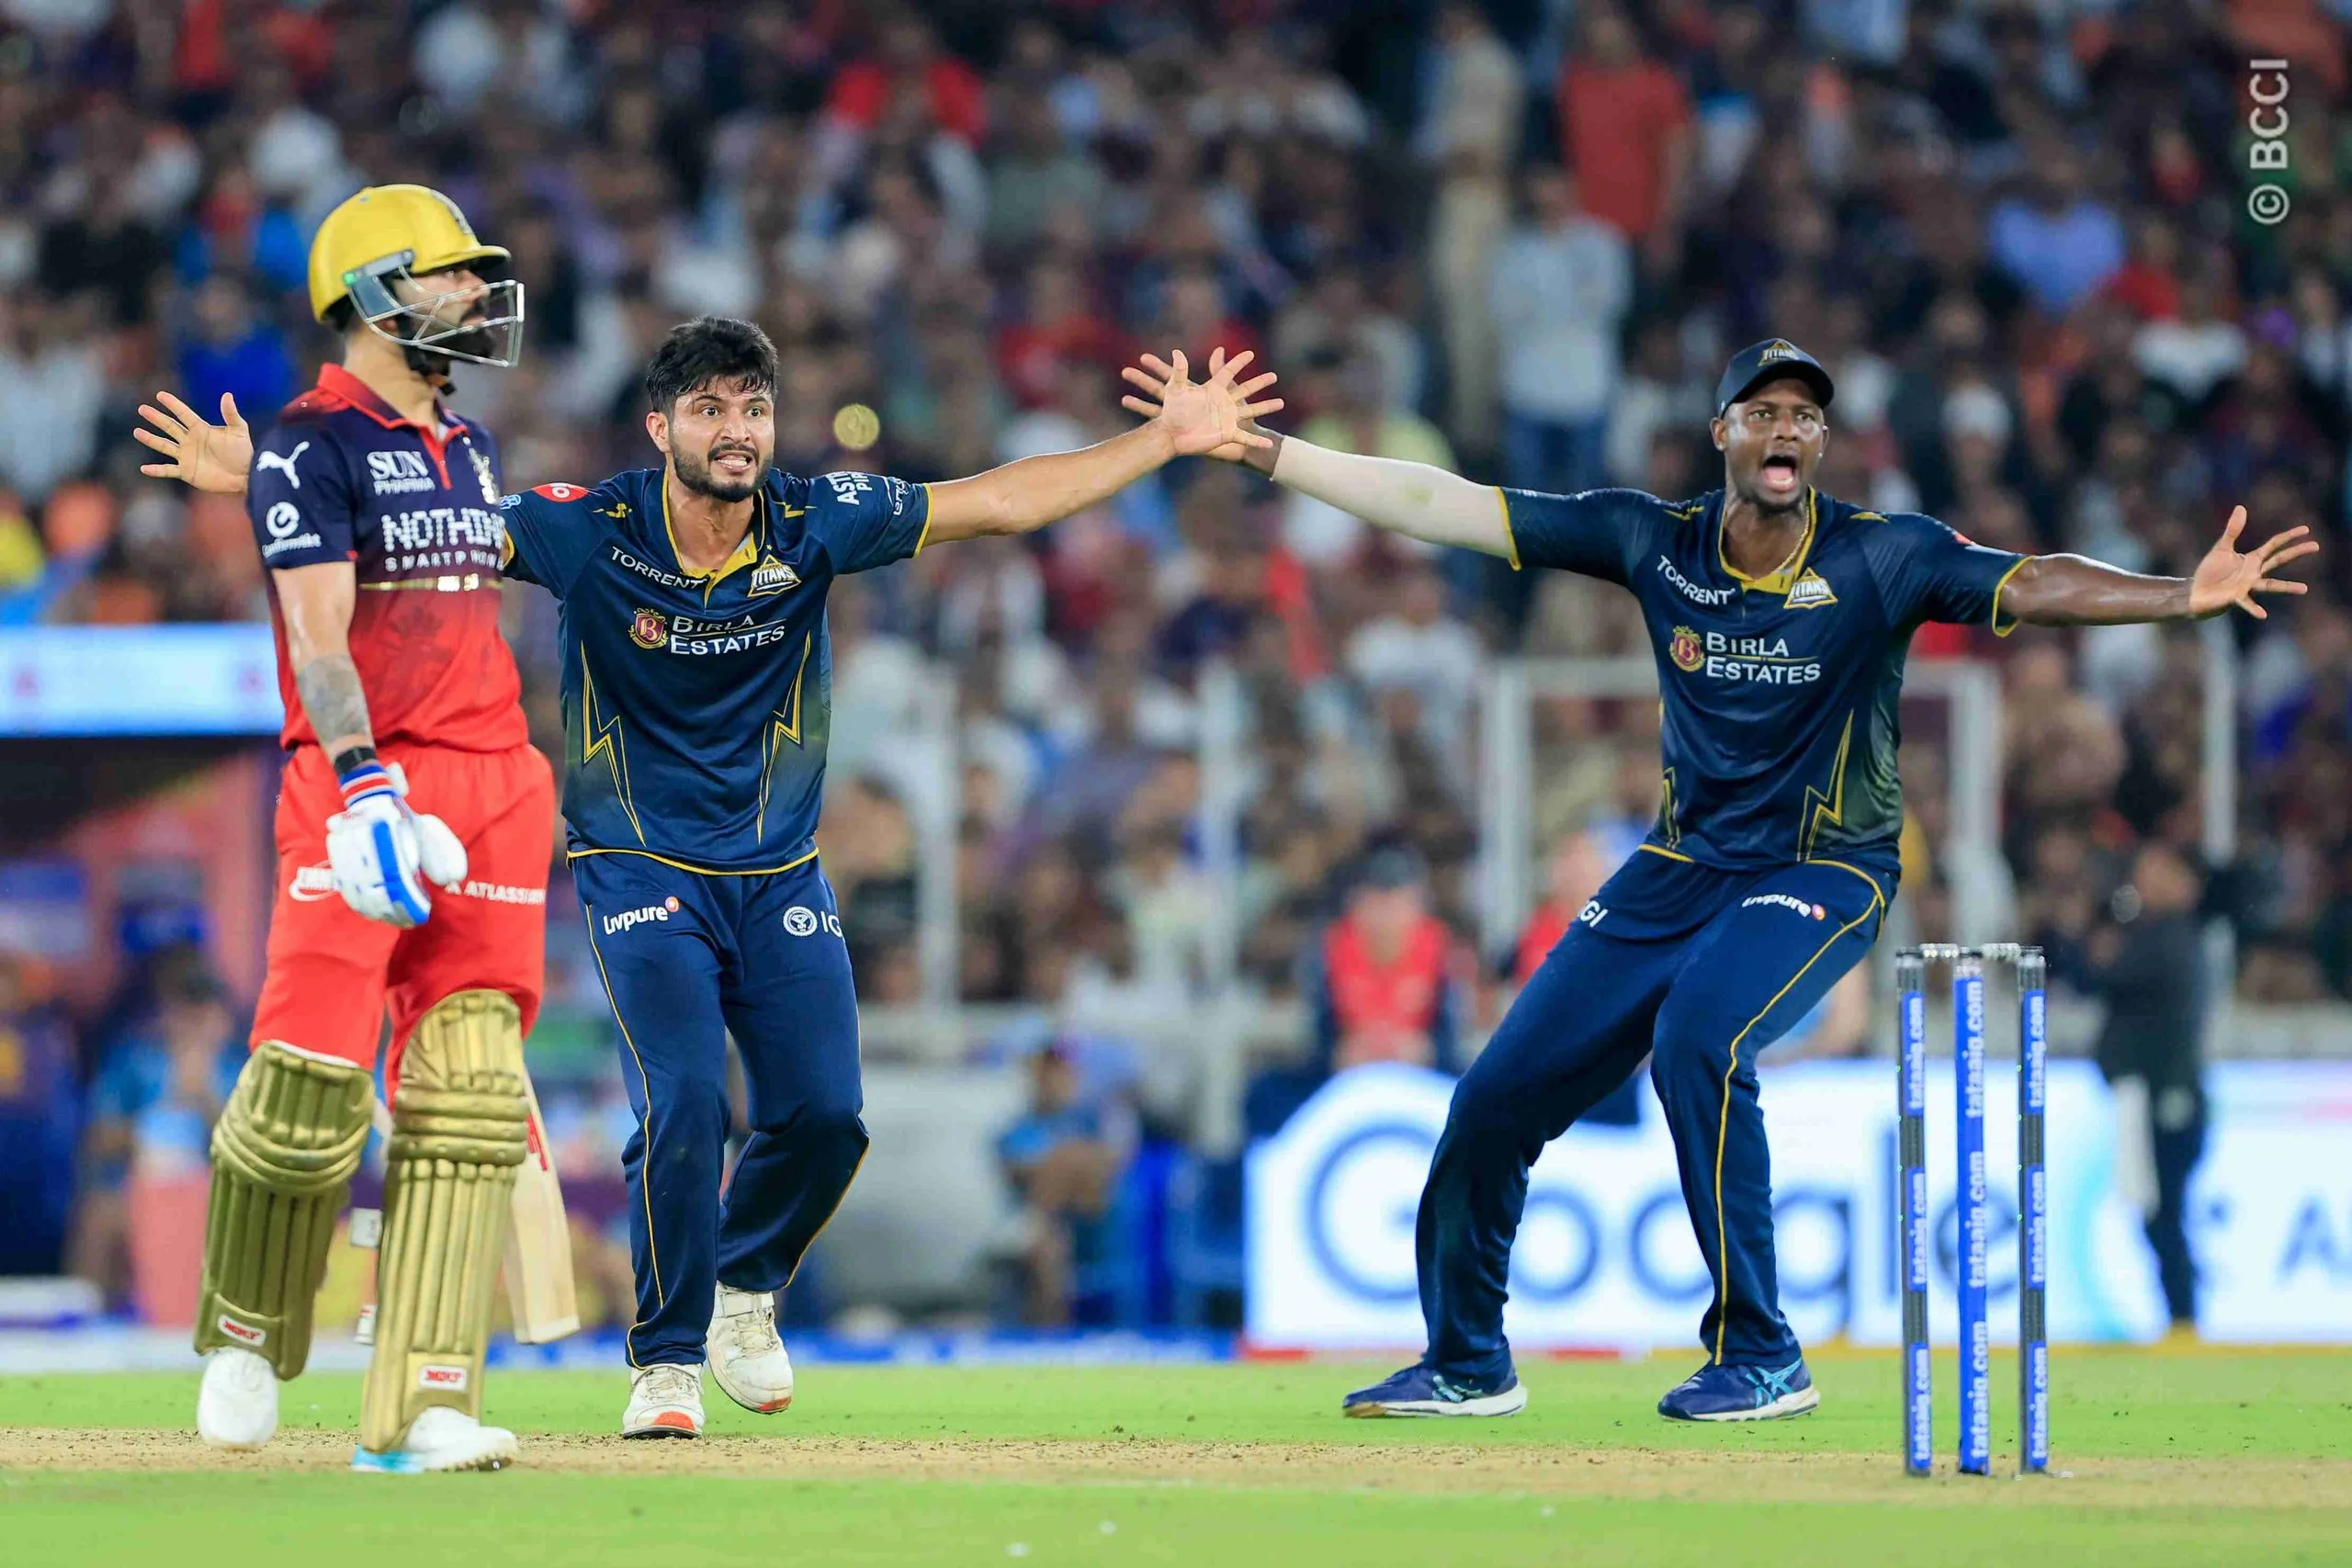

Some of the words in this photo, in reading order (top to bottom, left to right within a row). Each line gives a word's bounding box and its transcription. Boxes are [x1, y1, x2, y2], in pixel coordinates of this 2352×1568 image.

[367, 450, 429, 480] SUN
[380, 507, 505, 552] NOTHIN
[612, 546, 707, 590] TORRENT
[752, 564, 797, 588] TITANS
[1657, 555, 1736, 605] TORRENT
[673, 615, 755, 634] BIRLA
[670, 626, 786, 656] ESTATES
[1706, 631, 1790, 657] BIRLA
[1706, 656, 1822, 685] ESTATES
[1578, 900, 1609, 928] GI
